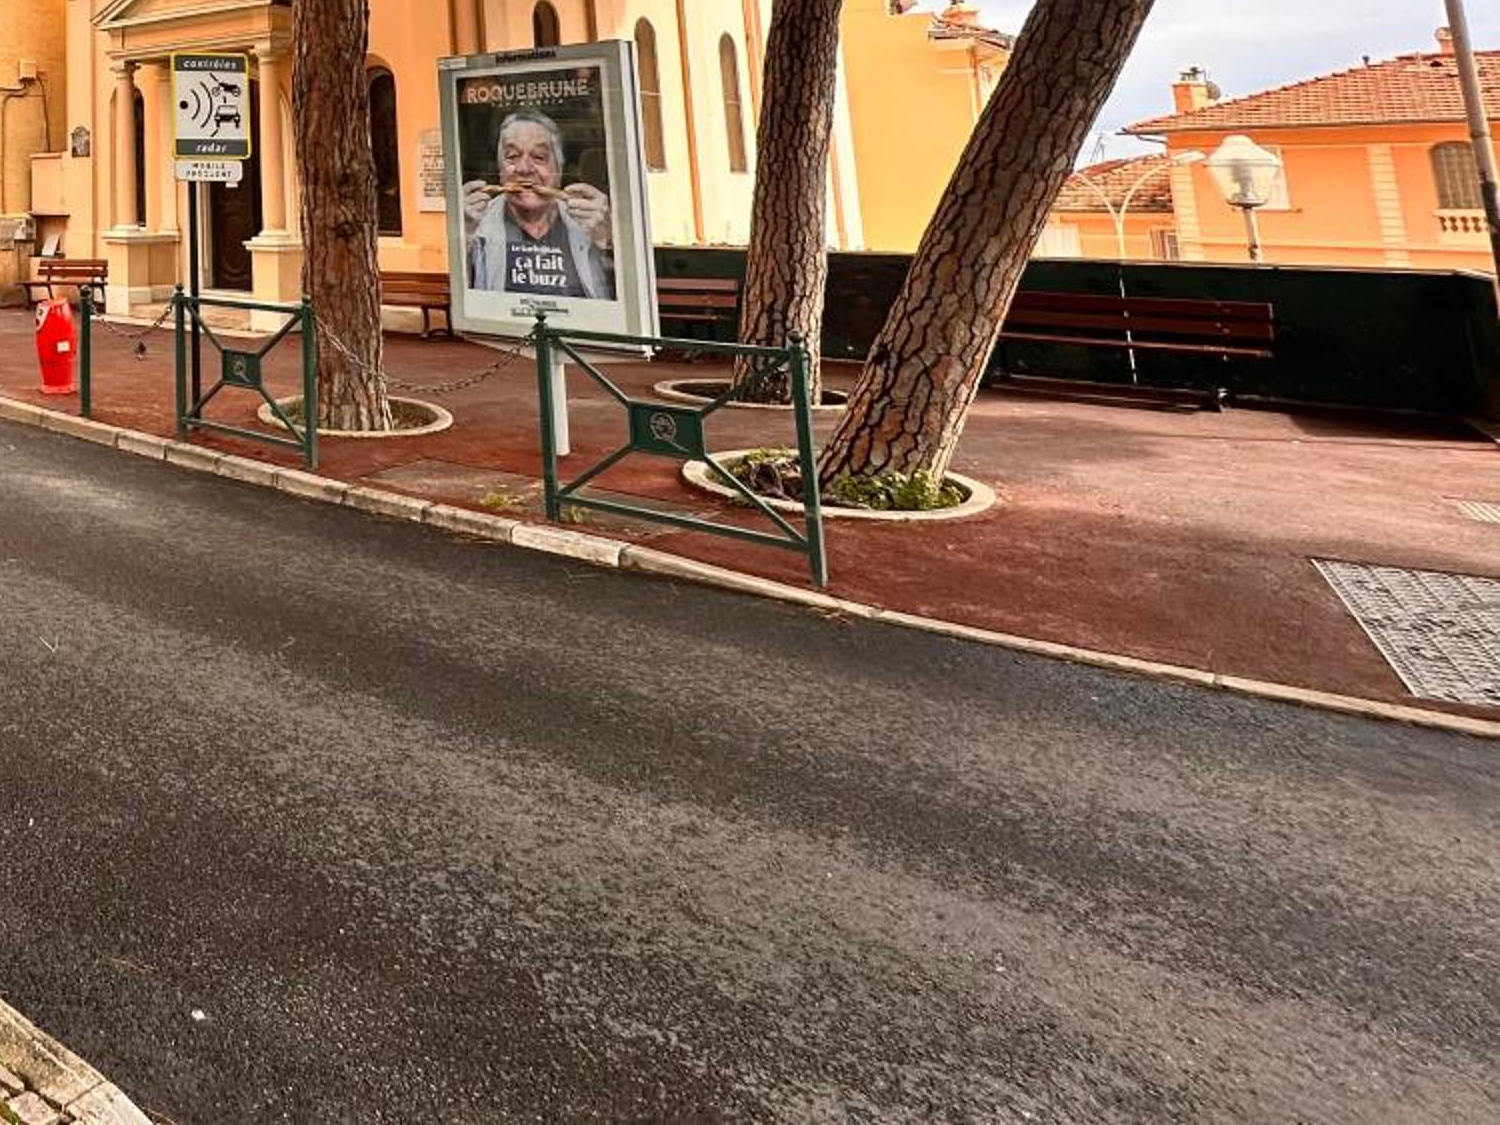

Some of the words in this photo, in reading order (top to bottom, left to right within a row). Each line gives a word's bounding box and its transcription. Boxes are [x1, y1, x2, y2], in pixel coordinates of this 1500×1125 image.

[467, 79, 590, 104] ROQUEBRUNE
[196, 142, 227, 153] radar
[515, 256, 533, 271] ça
[535, 254, 564, 272] fait
[511, 268, 527, 284] le
[529, 268, 568, 287] buzz
